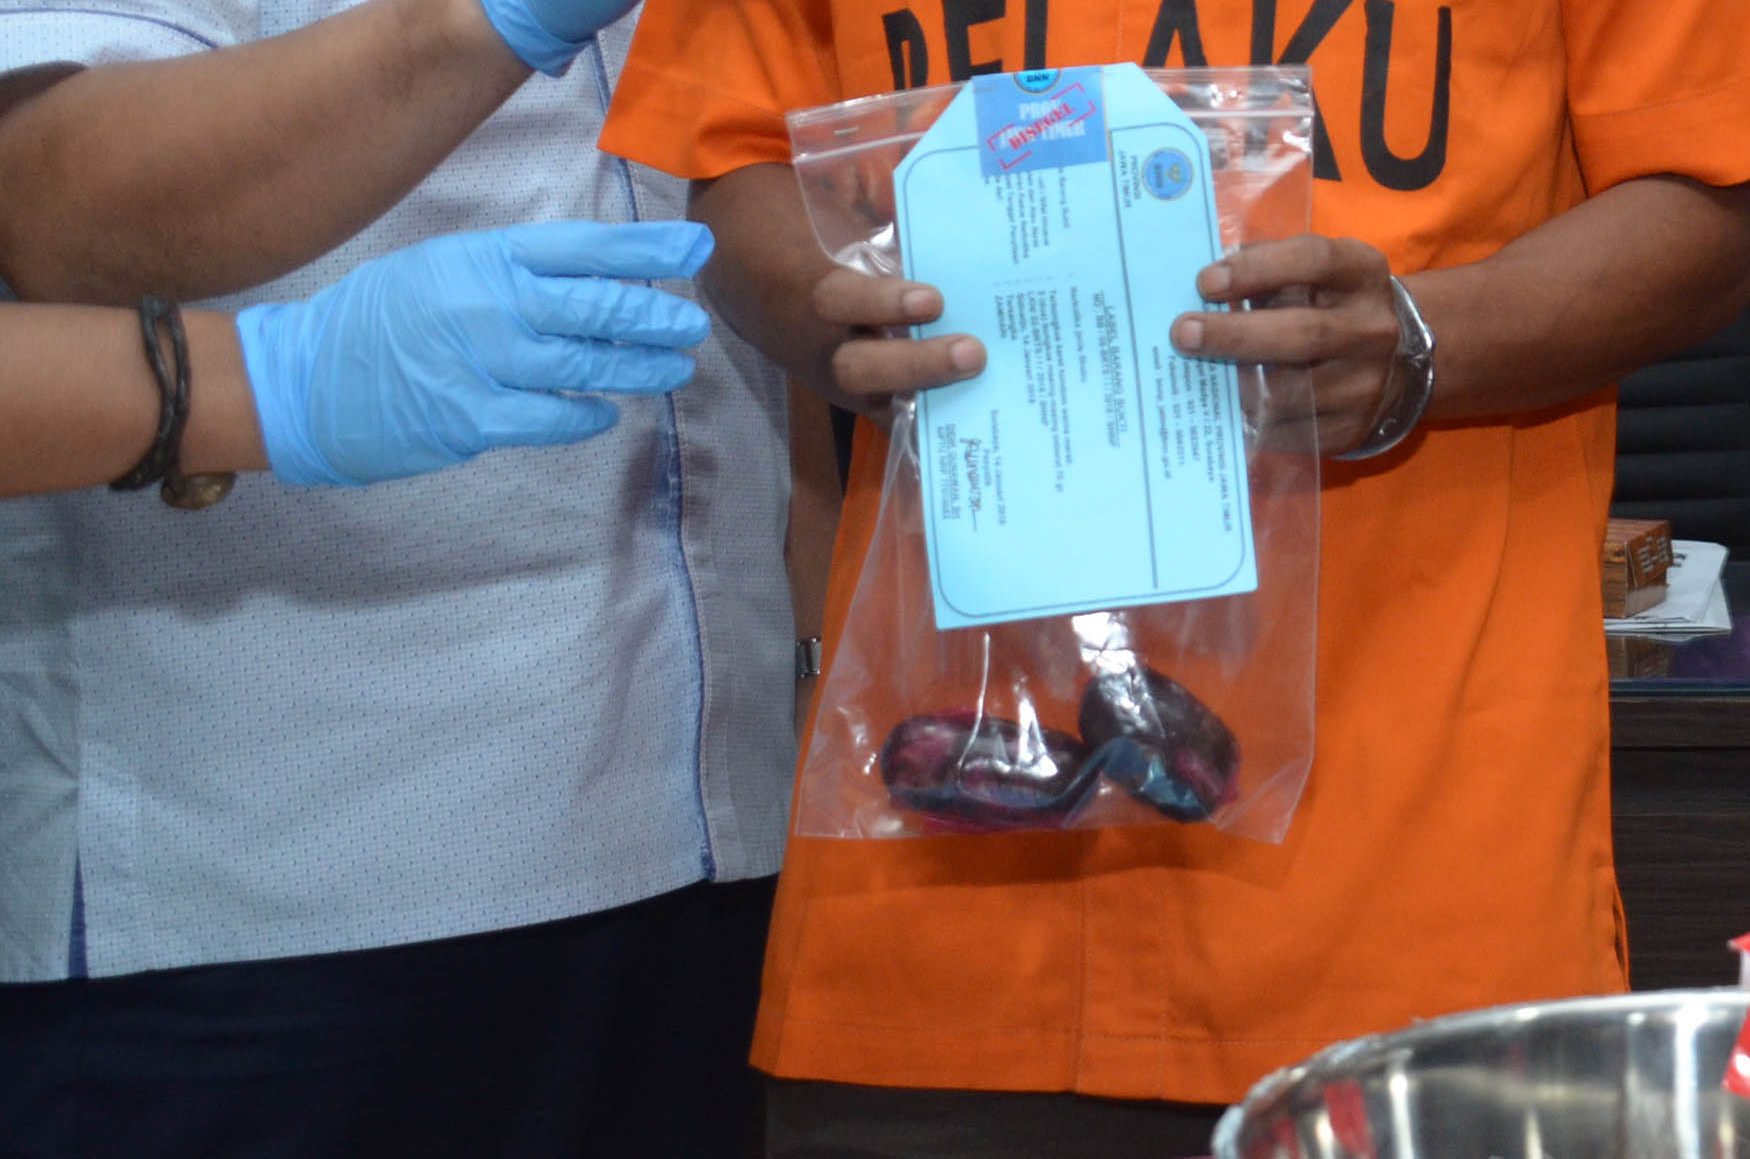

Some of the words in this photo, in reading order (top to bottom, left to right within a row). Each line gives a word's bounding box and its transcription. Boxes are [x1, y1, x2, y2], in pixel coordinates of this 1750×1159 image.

[1105, 305, 1118, 343] LABEL
[1109, 345, 1123, 394] BARANG
[1115, 397, 1128, 433] BUKTI
